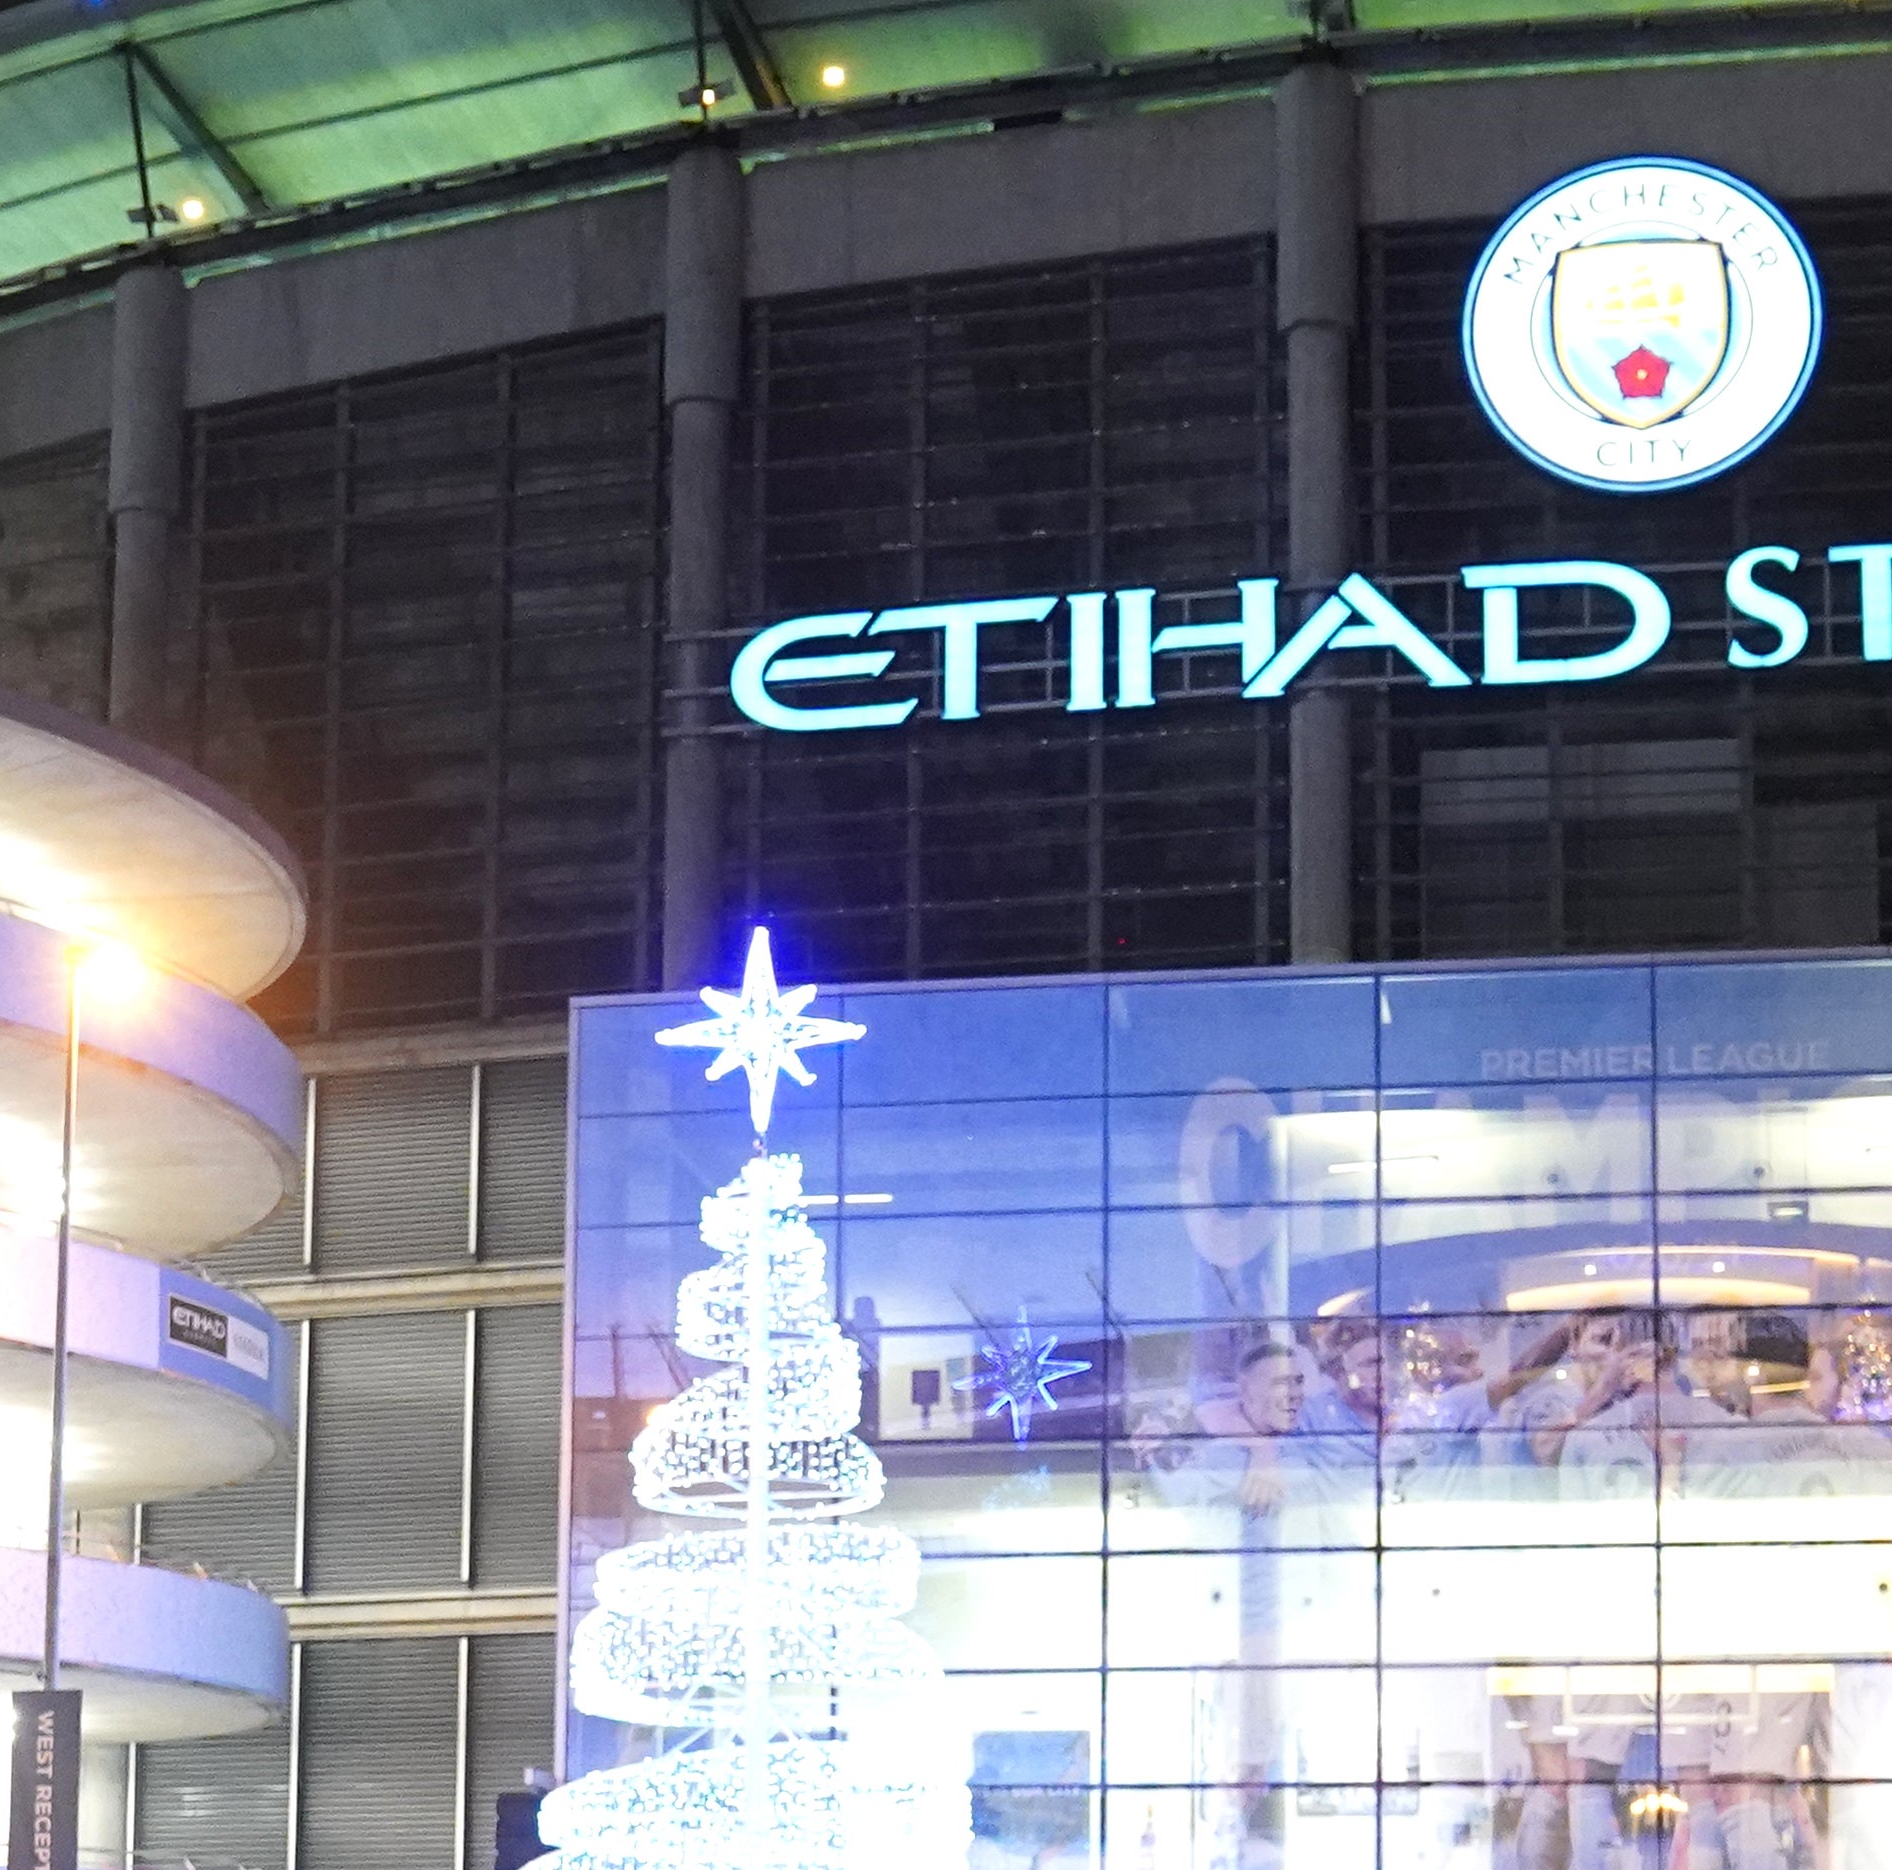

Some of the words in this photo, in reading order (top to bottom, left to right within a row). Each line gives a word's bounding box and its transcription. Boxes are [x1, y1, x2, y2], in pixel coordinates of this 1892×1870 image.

[1502, 182, 1780, 287] MANCHESTER
[1595, 437, 1693, 468] CITY
[729, 559, 1672, 733] ETIHAD
[1479, 1043, 1653, 1080] PREMIER
[1667, 1039, 1831, 1073] LEAGUE
[35, 1709, 55, 1779] WEST
